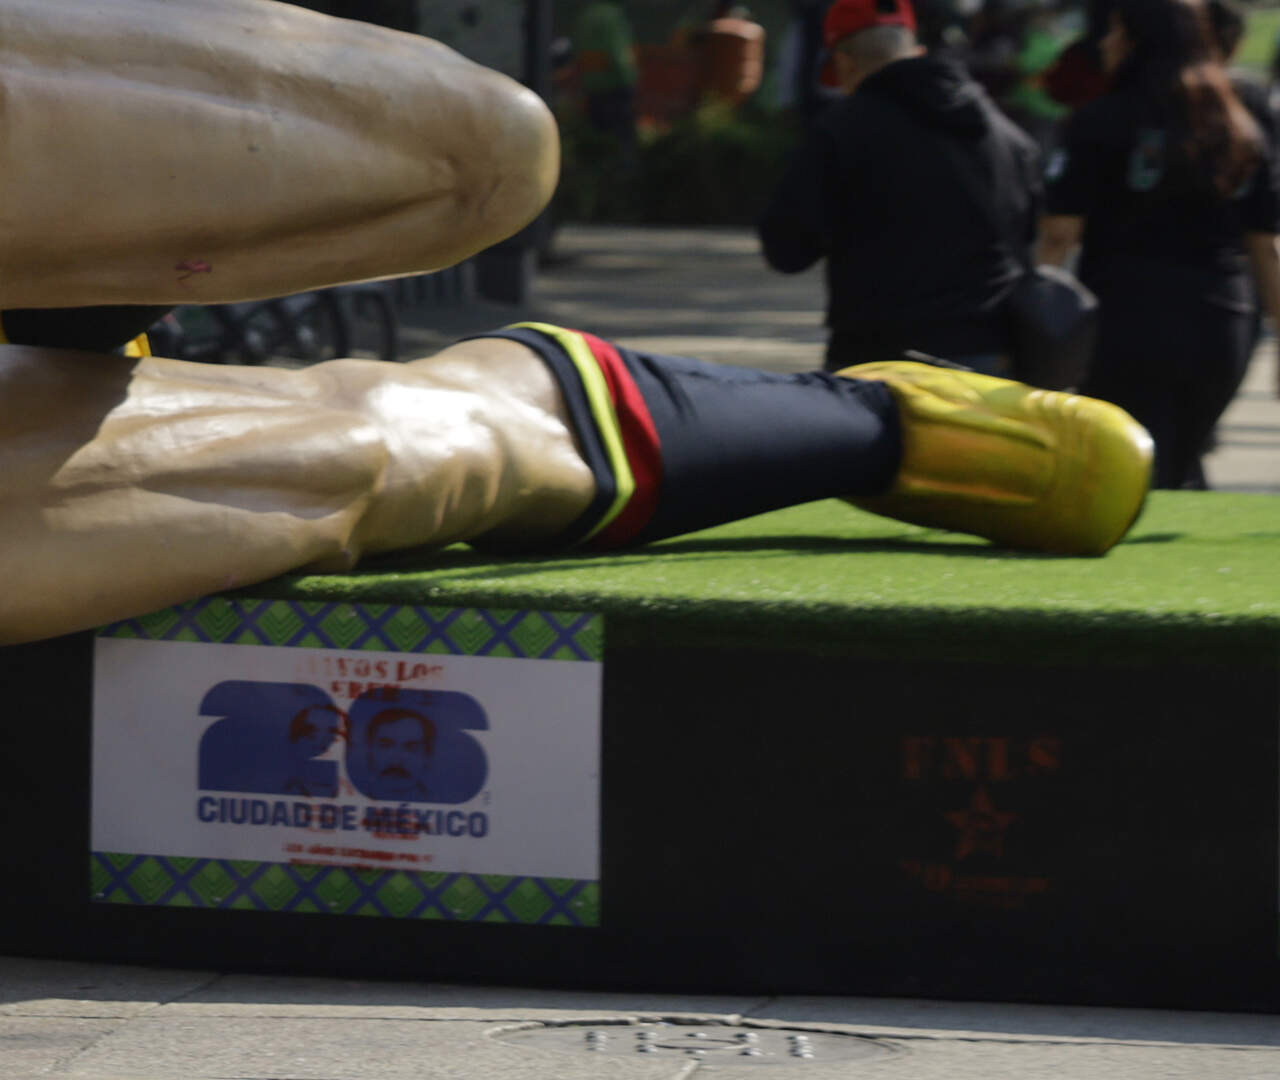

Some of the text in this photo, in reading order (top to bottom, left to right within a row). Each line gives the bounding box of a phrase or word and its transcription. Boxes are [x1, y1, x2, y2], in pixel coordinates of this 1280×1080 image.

[198, 680, 489, 804] 26
[197, 796, 488, 838] CIUDAD DE MÉXICO
